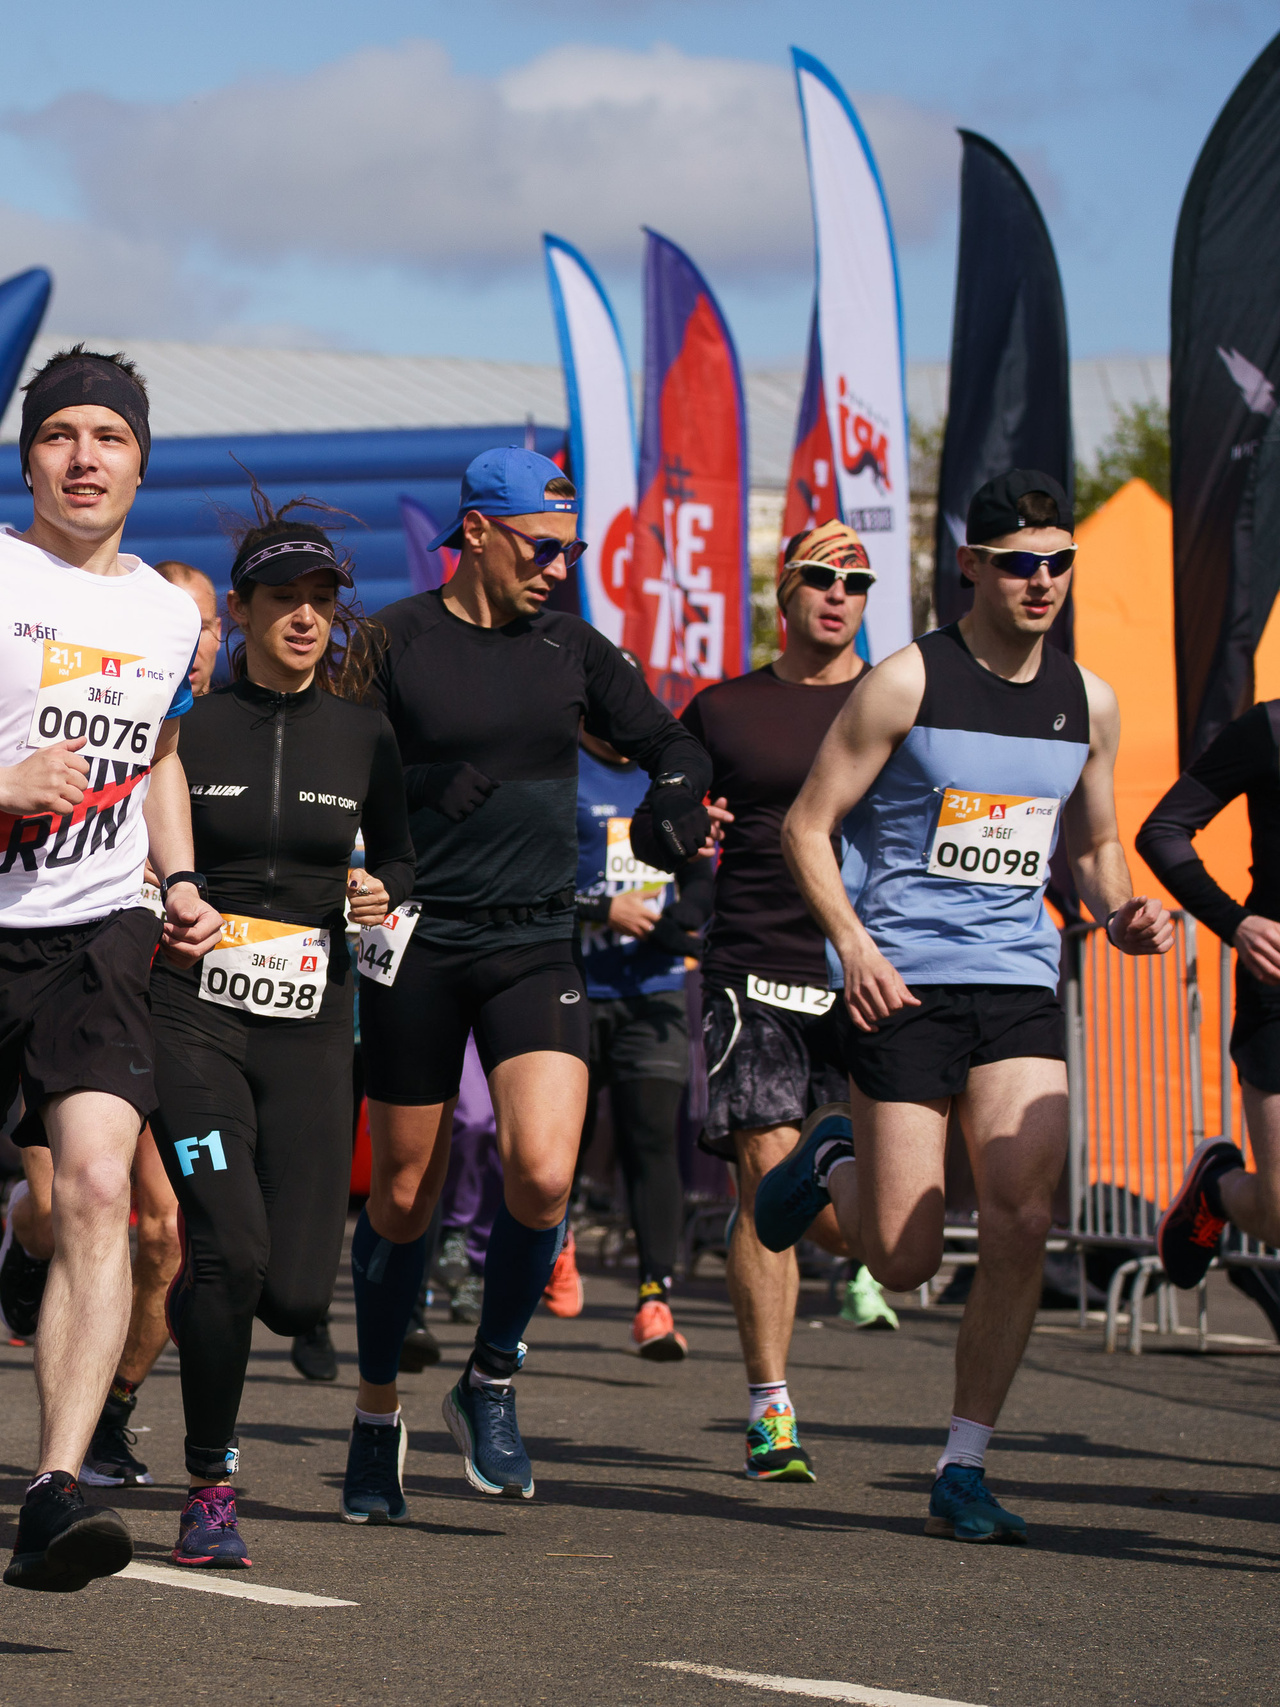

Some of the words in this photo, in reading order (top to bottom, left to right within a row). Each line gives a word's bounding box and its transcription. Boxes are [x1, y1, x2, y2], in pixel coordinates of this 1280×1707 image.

[49, 647, 82, 670] 21,1
[38, 705, 152, 754] 00076
[299, 791, 316, 803] DO
[318, 793, 337, 806] NOT
[337, 796, 358, 812] COPY
[947, 794, 982, 814] 21,1
[937, 841, 1041, 877] 00098
[207, 966, 317, 1011] 00038
[173, 1130, 228, 1178] F1
